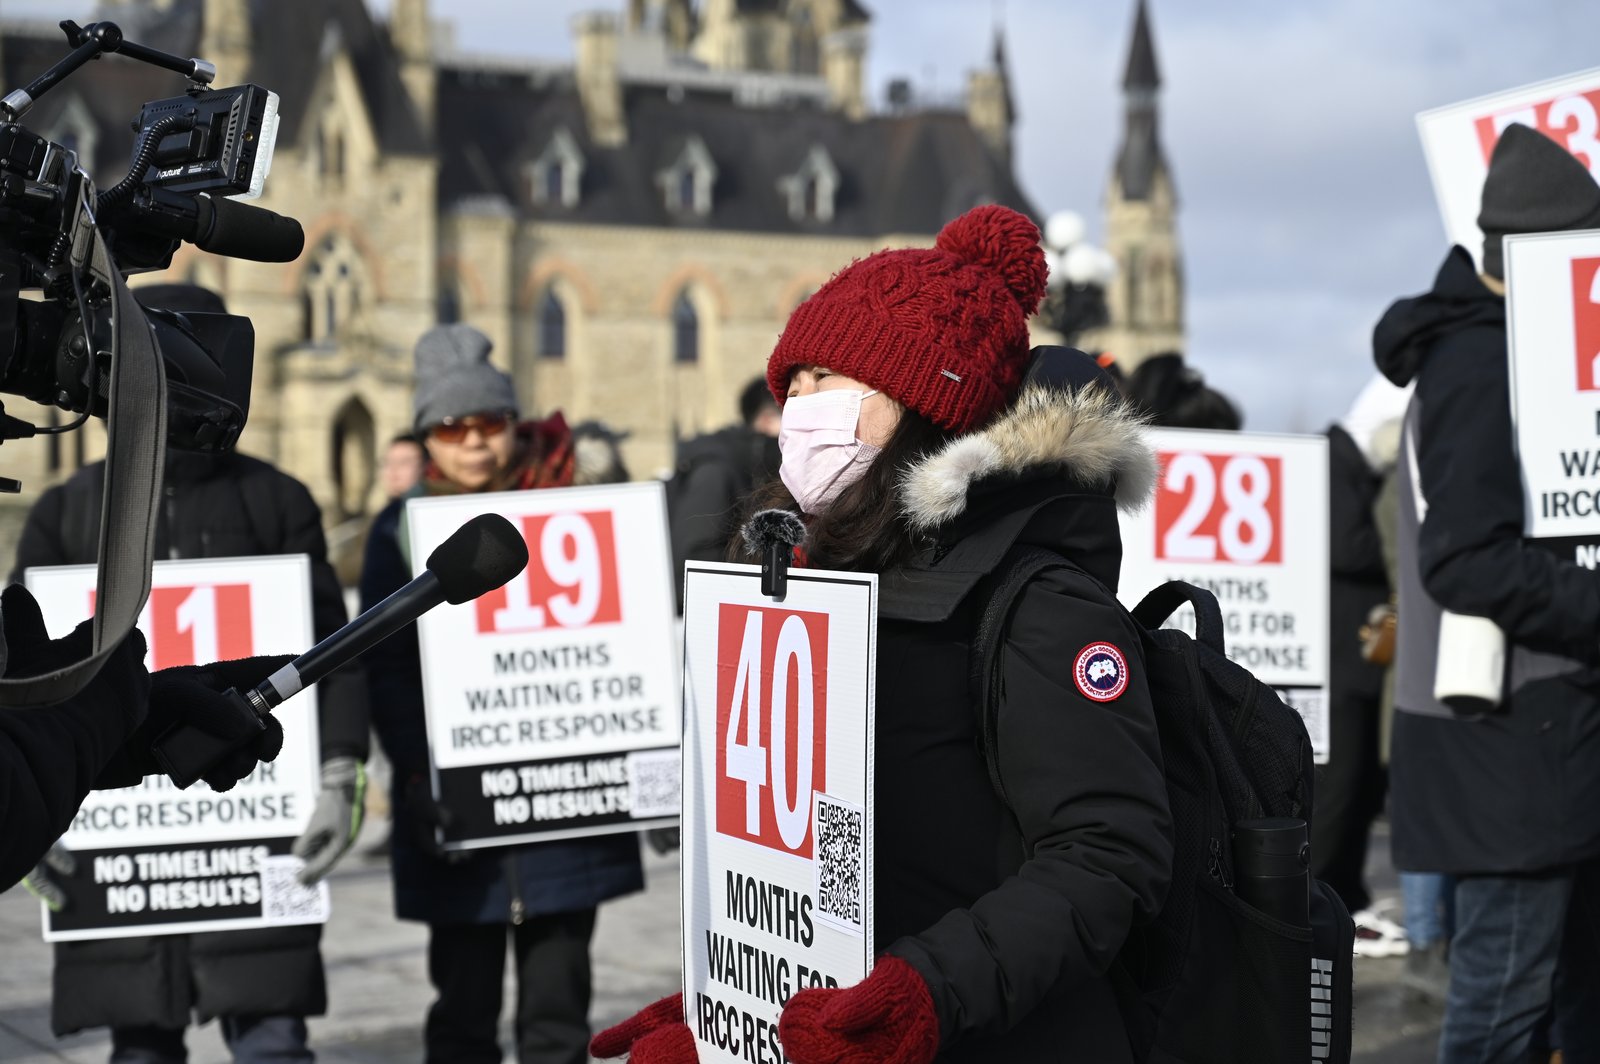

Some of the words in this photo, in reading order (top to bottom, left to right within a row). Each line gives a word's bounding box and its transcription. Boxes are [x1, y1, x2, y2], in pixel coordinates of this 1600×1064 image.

[1493, 95, 1600, 188] 3
[1164, 453, 1273, 563] 28
[494, 512, 602, 632] 19
[1575, 544, 1600, 571] N
[1166, 578, 1269, 602] NTHS
[1250, 612, 1296, 636] FOR
[494, 643, 611, 673] MONTHS
[1229, 645, 1308, 670] PONSE
[466, 681, 582, 712] WAITING
[592, 675, 644, 702] FOR
[451, 721, 511, 749] IRCC
[518, 707, 663, 743] RESPONSE
[726, 609, 814, 850] 40
[481, 768, 518, 798] NO
[518, 757, 628, 793] TIMELINE
[73, 804, 129, 831] RCC
[136, 794, 297, 829] RESPONSE
[493, 795, 530, 825] NO
[532, 785, 629, 821] RESULTS
[94, 854, 134, 884] NO
[134, 845, 269, 881] TIMELINES
[106, 884, 146, 914] NO
[149, 876, 261, 911] RESULTS
[726, 869, 814, 948] MONTHS
[706, 929, 790, 1009] WAITING
[697, 992, 740, 1056] IRCC
[1311, 957, 1333, 1064] UMA
